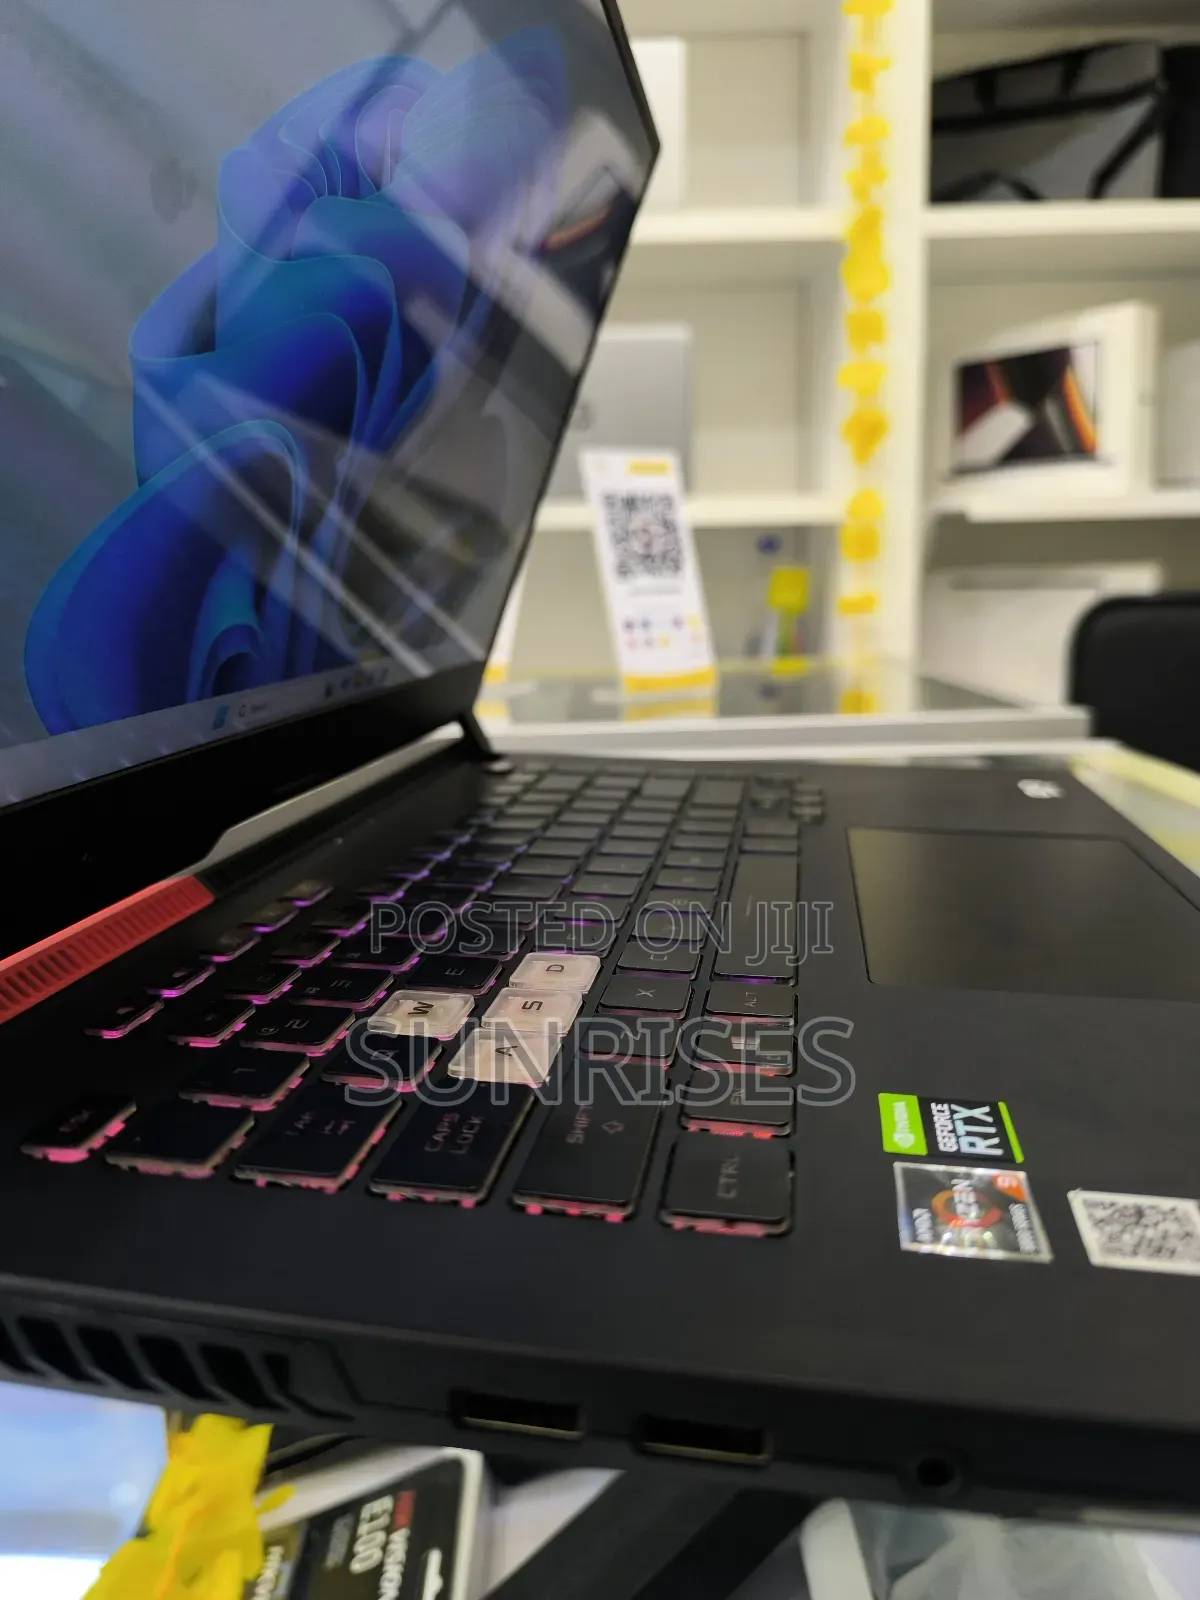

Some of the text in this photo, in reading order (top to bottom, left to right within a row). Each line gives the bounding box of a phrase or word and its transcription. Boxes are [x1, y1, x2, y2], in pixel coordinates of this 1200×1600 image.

[445, 967, 465, 977] E
[545, 963, 565, 973] D
[635, 987, 657, 998] X
[744, 991, 757, 1009] ALT
[407, 1000, 435, 1016] W
[521, 1000, 544, 1012] S
[494, 1044, 519, 1058] A
[423, 1111, 462, 1153] CAPS
[448, 1113, 486, 1155] LOCK
[930, 1102, 959, 1153] GEFORCE
[950, 1103, 1004, 1156] RTX
[716, 1153, 744, 1200] CTRL
[349, 1495, 393, 1575] E100
